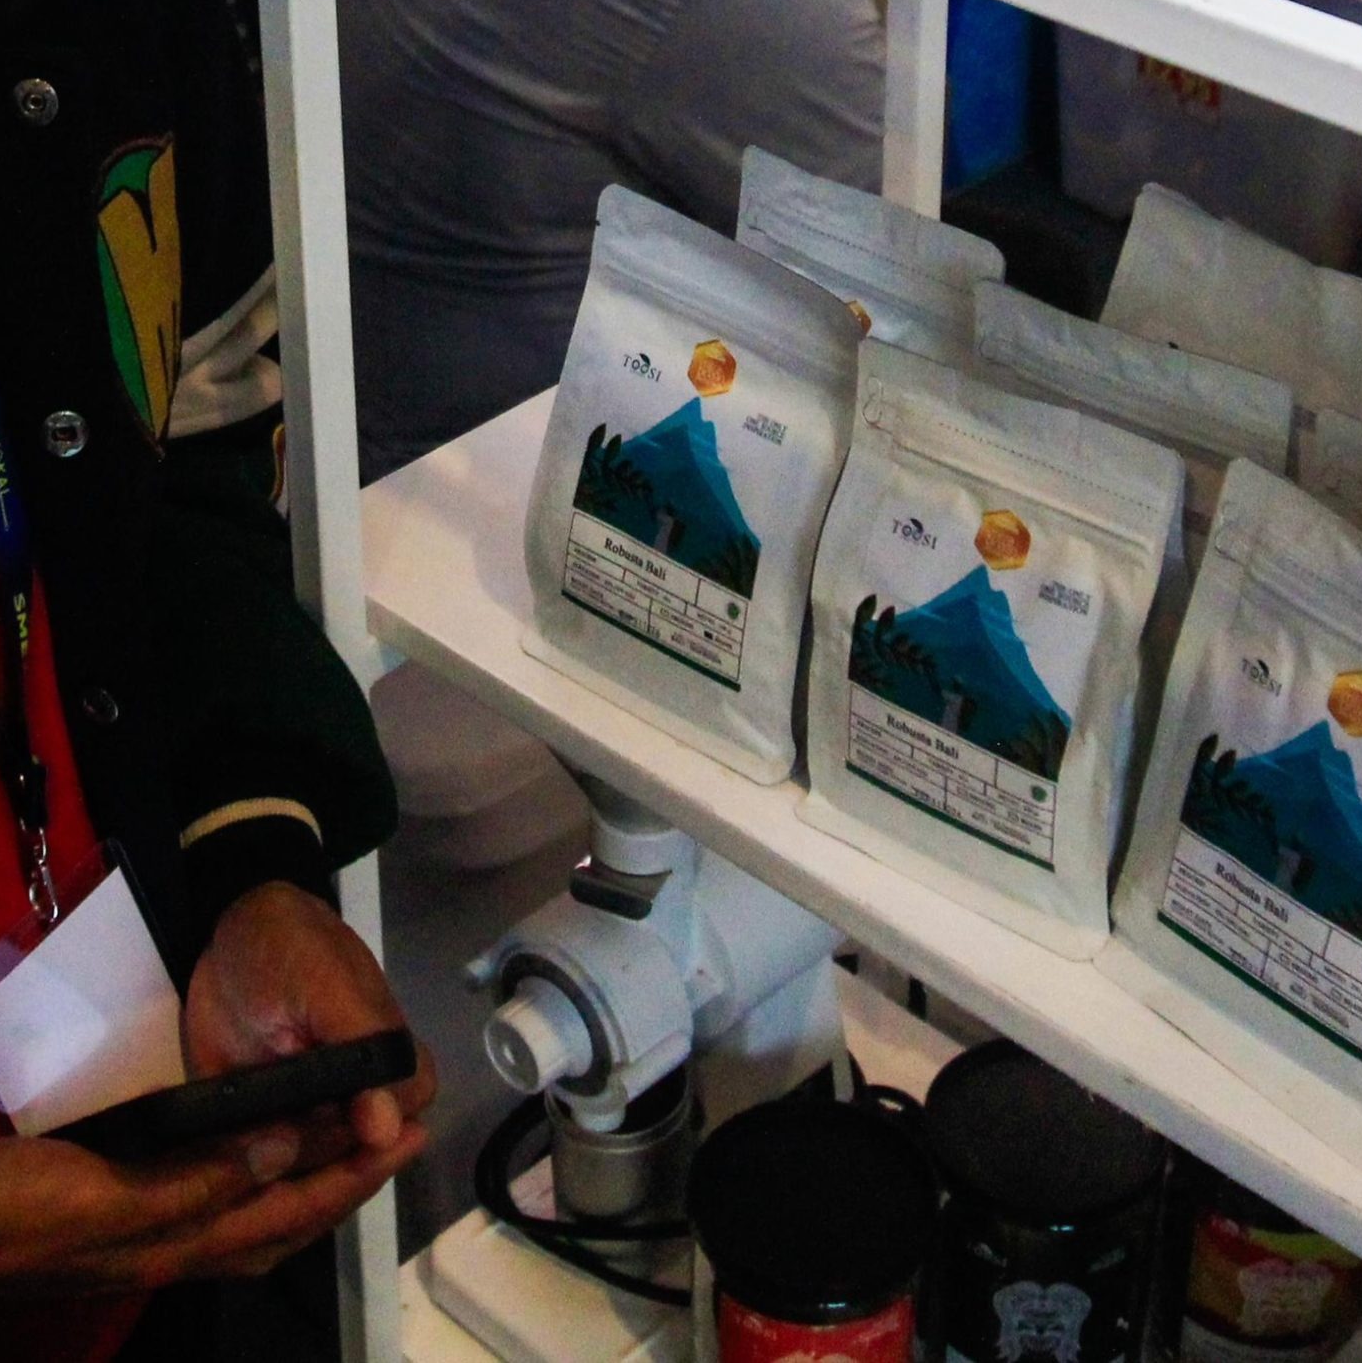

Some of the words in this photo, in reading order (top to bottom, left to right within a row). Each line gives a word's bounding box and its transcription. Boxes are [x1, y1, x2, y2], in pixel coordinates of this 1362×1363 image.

[622, 354, 662, 382] TOOSI
[892, 518, 937, 550] TOOSI
[604, 537, 644, 568] Robusta
[645, 559, 667, 581] Bali
[887, 714, 932, 746] Robusta
[936, 738, 960, 760] Bali
[1215, 862, 1261, 904] Robusta
[1264, 896, 1289, 923] Bali
